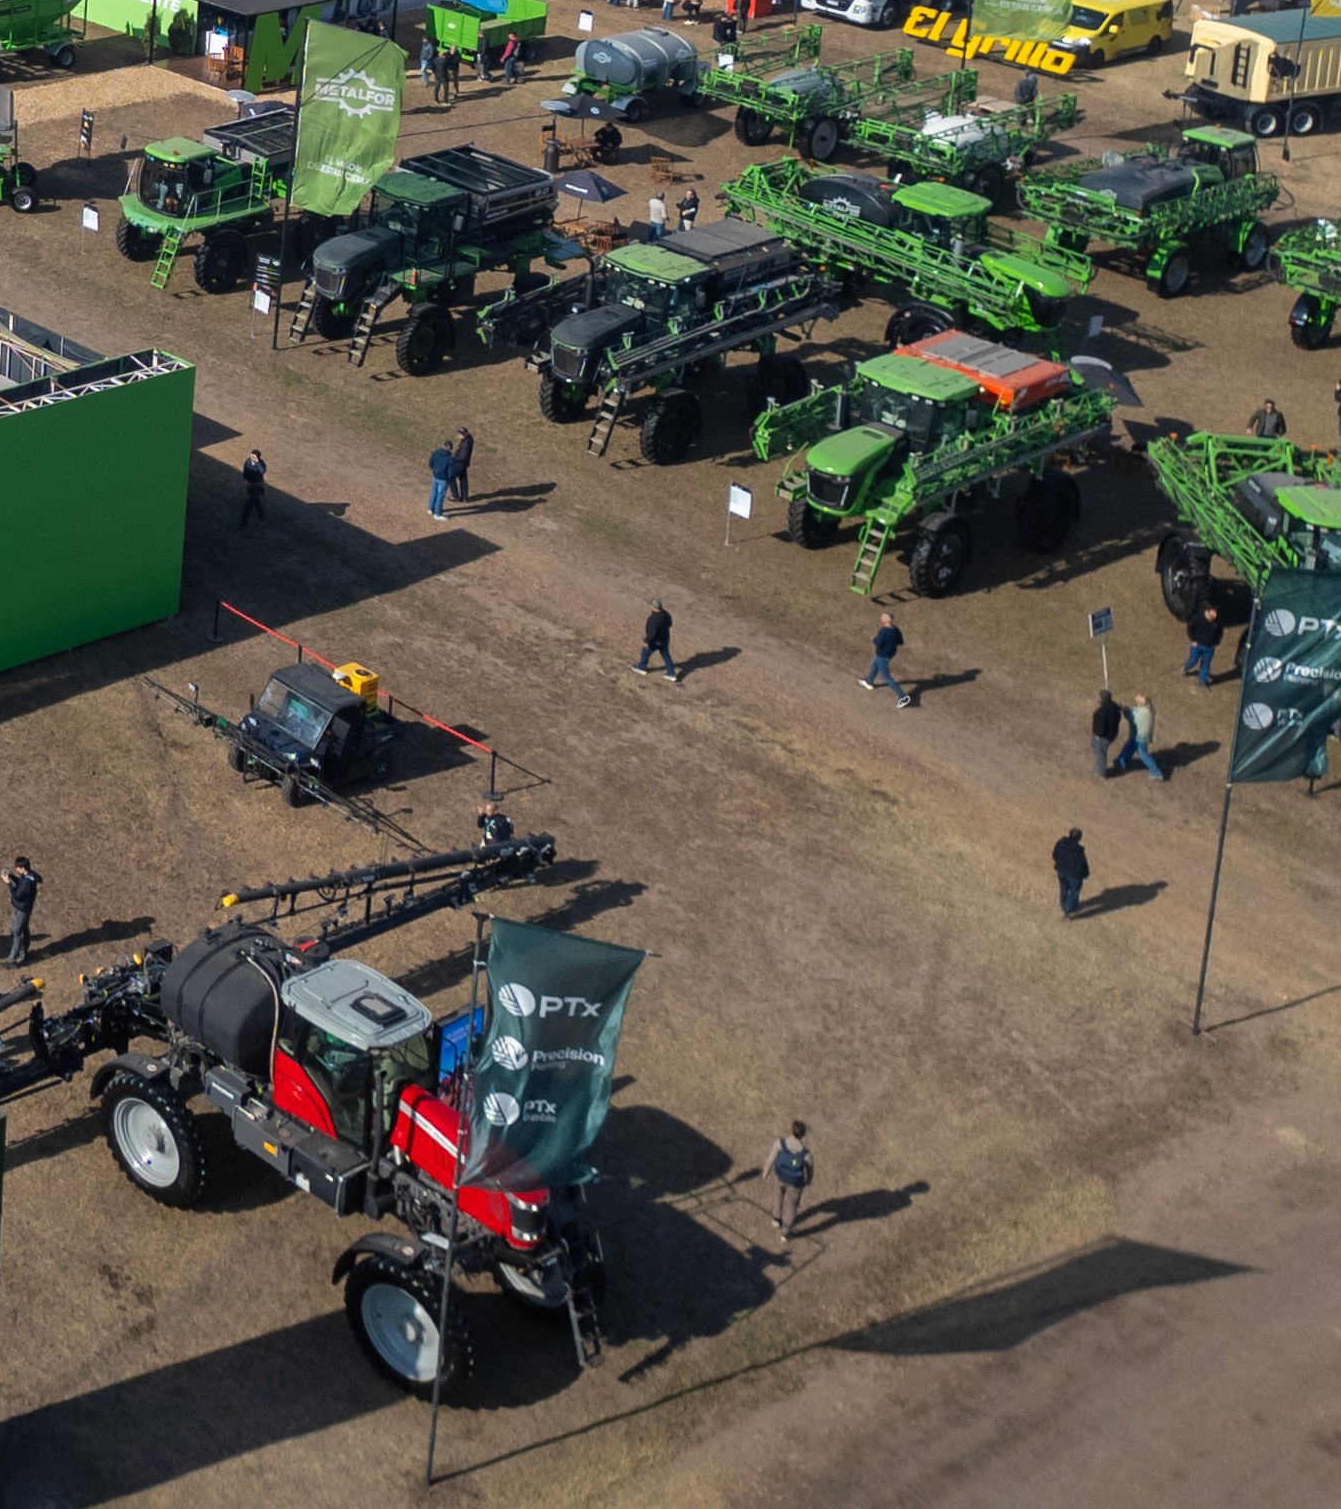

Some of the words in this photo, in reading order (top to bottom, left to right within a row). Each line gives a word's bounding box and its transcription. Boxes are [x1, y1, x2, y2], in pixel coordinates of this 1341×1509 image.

[314, 84, 396, 107] METALFOR
[539, 995, 602, 1019] PTx
[532, 1046, 606, 1067] Precision
[523, 1099, 557, 1114] PTx
